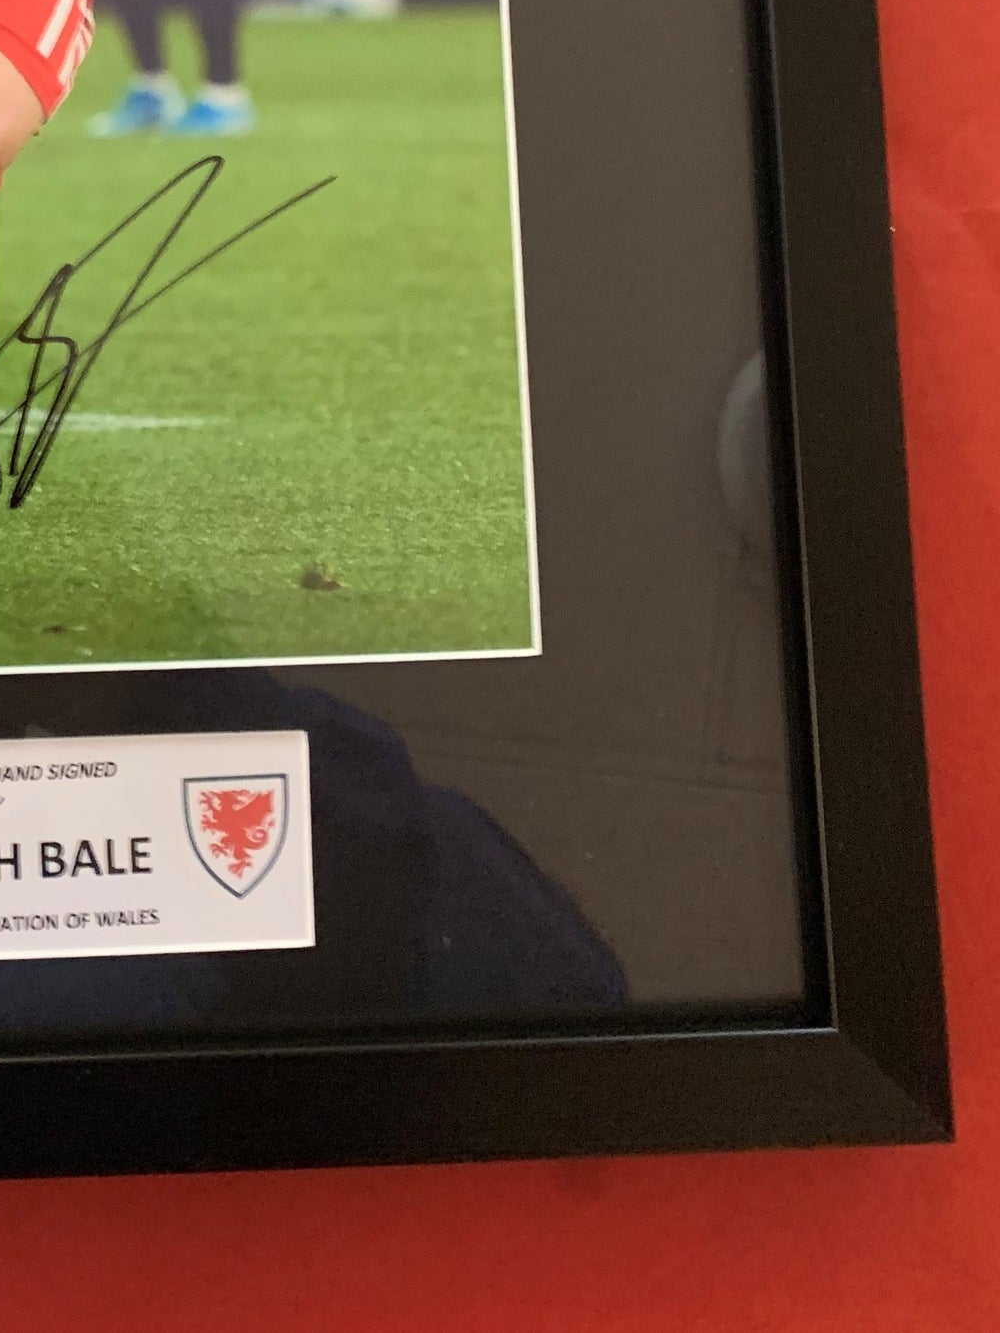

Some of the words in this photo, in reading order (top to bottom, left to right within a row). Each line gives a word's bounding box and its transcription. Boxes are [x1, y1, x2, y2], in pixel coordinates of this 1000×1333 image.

[47, 761, 117, 780] SIGNED
[39, 836, 153, 879] BALE
[65, 911, 92, 929] OF
[93, 908, 161, 928] WALES
